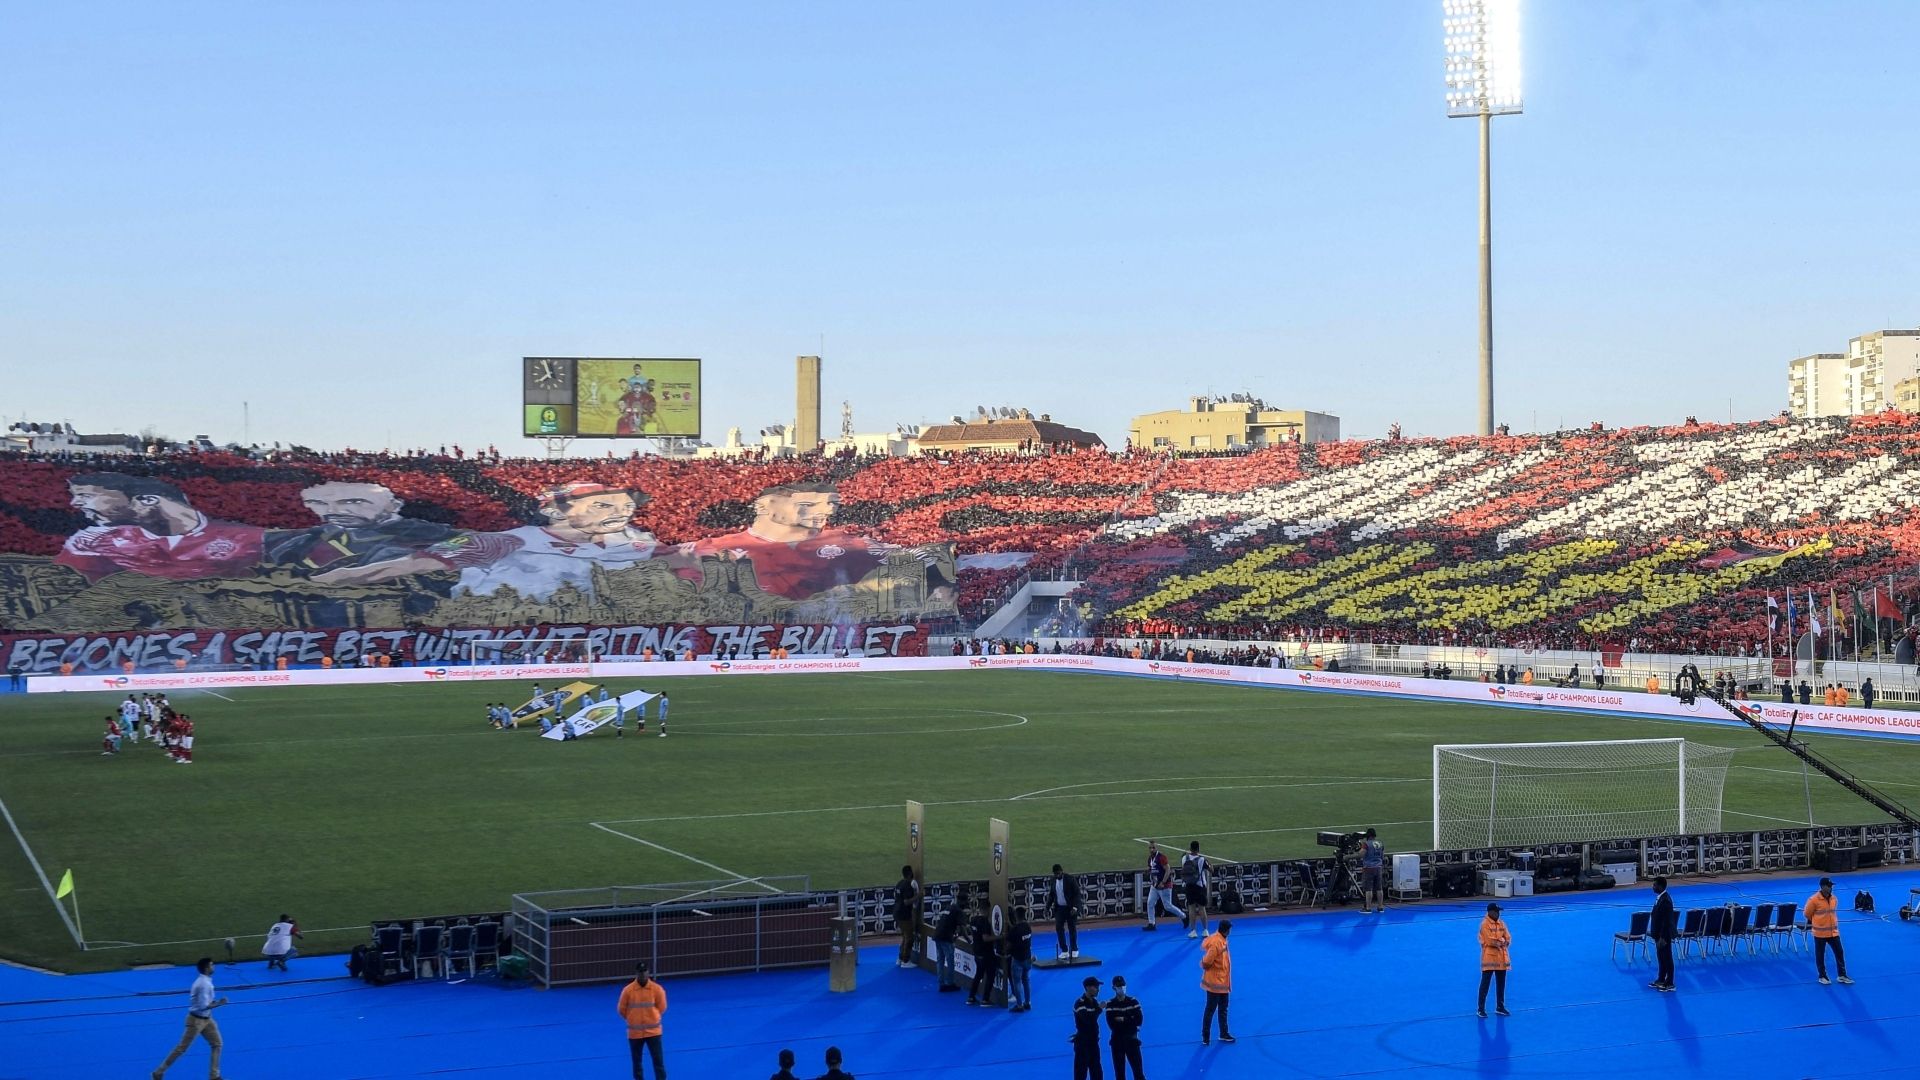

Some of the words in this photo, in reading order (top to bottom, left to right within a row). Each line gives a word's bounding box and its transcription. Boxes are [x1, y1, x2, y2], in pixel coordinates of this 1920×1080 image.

[7, 632, 198, 671] BECOMES
[201, 631, 226, 665] A
[232, 630, 328, 664] SAFE
[333, 630, 417, 661] BET
[414, 627, 587, 660] WITHOUT
[586, 626, 696, 656] BITING
[705, 625, 775, 656] THE
[780, 625, 916, 657] BULLET
[448, 670, 496, 678] TotalEnergies
[732, 664, 776, 672] TotalEnergies
[1160, 665, 1183, 674] TotalEnergies
[1192, 667, 1214, 675] CHAMPIONS
[1215, 668, 1231, 676] LEAGUE
[131, 678, 185, 687] TotalEnergies
[208, 676, 256, 684] CHAMPIONS
[258, 674, 290, 682] LEAGUE
[1312, 675, 1341, 685] TotalEnergies
[1353, 679, 1381, 688] CHAMPIONS
[1382, 680, 1402, 689] LEAGUE
[1560, 694, 1597, 703] CHAMPIONS
[1598, 696, 1622, 705] LEAGUE
[574, 718, 595, 730] CAF
[1818, 712, 1834, 720] CAF
[1836, 714, 1886, 725] CHAMPIONS
[1887, 717, 1920, 728] LEAGUE
